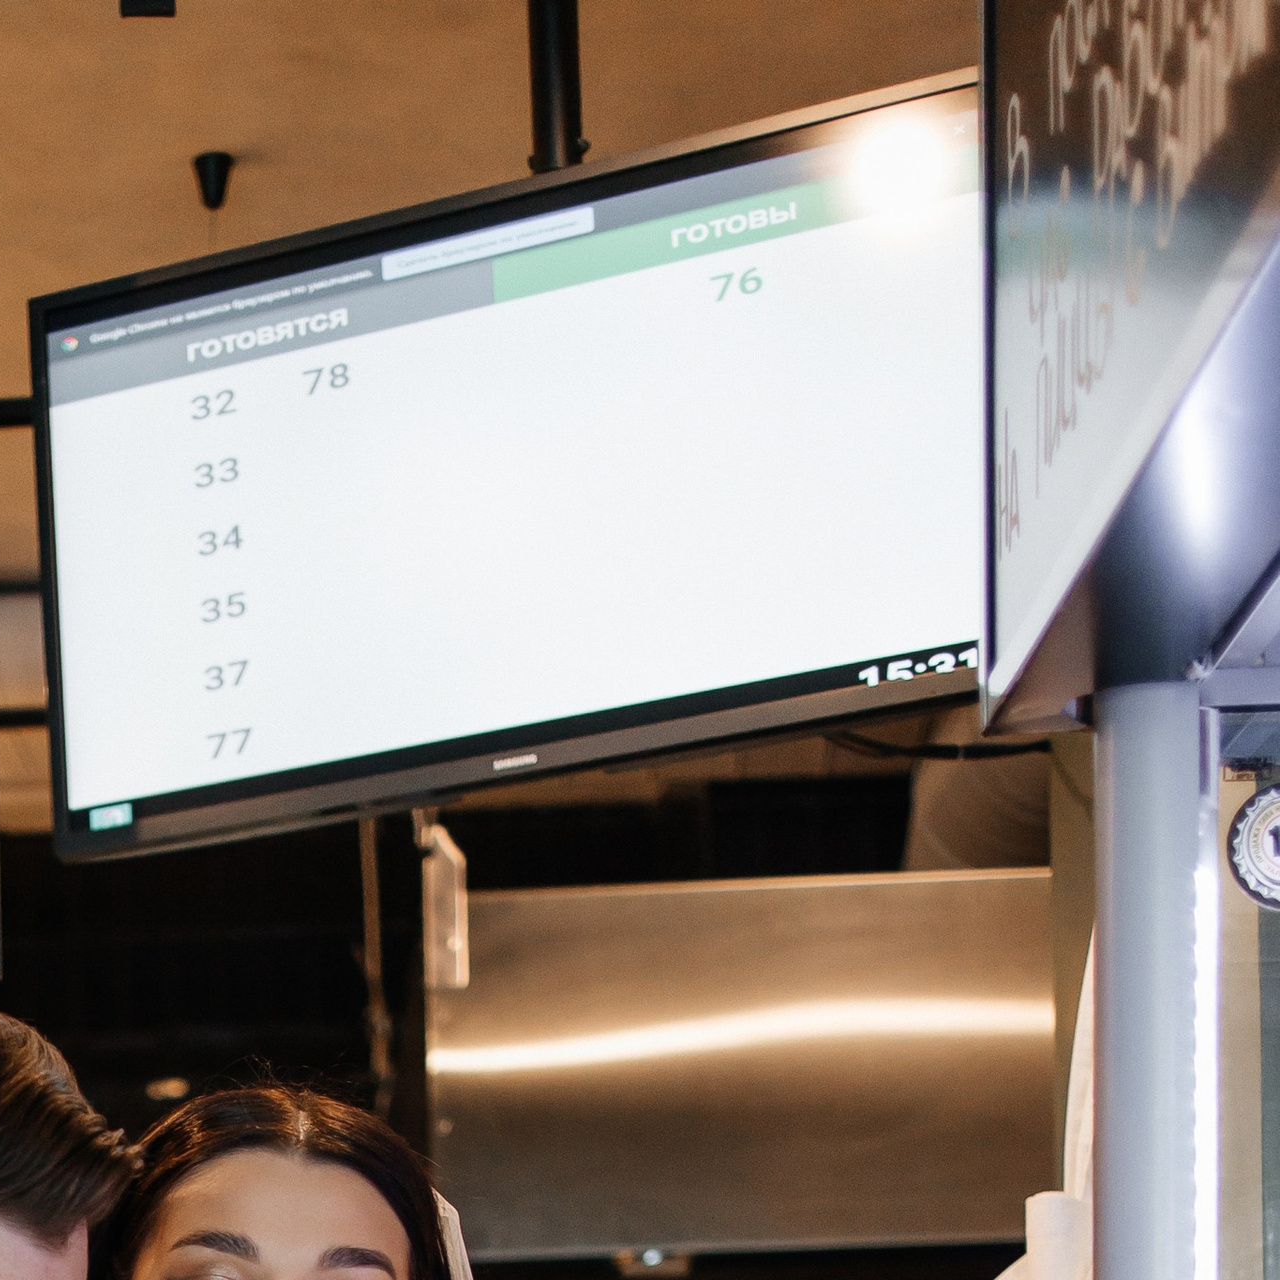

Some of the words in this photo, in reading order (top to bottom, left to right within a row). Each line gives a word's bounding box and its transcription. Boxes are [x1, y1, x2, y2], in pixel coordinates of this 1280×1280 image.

[670, 201, 797, 248] ГОТОВЫ
[709, 266, 763, 302] 76
[186, 308, 348, 362] ГОТОВЯТСЯ
[191, 390, 237, 420] 32
[303, 363, 350, 395] 78
[194, 458, 239, 488] 33
[198, 525, 243, 556] 34
[201, 592, 246, 623] 35
[205, 660, 249, 691] 37
[207, 728, 252, 760] 77
